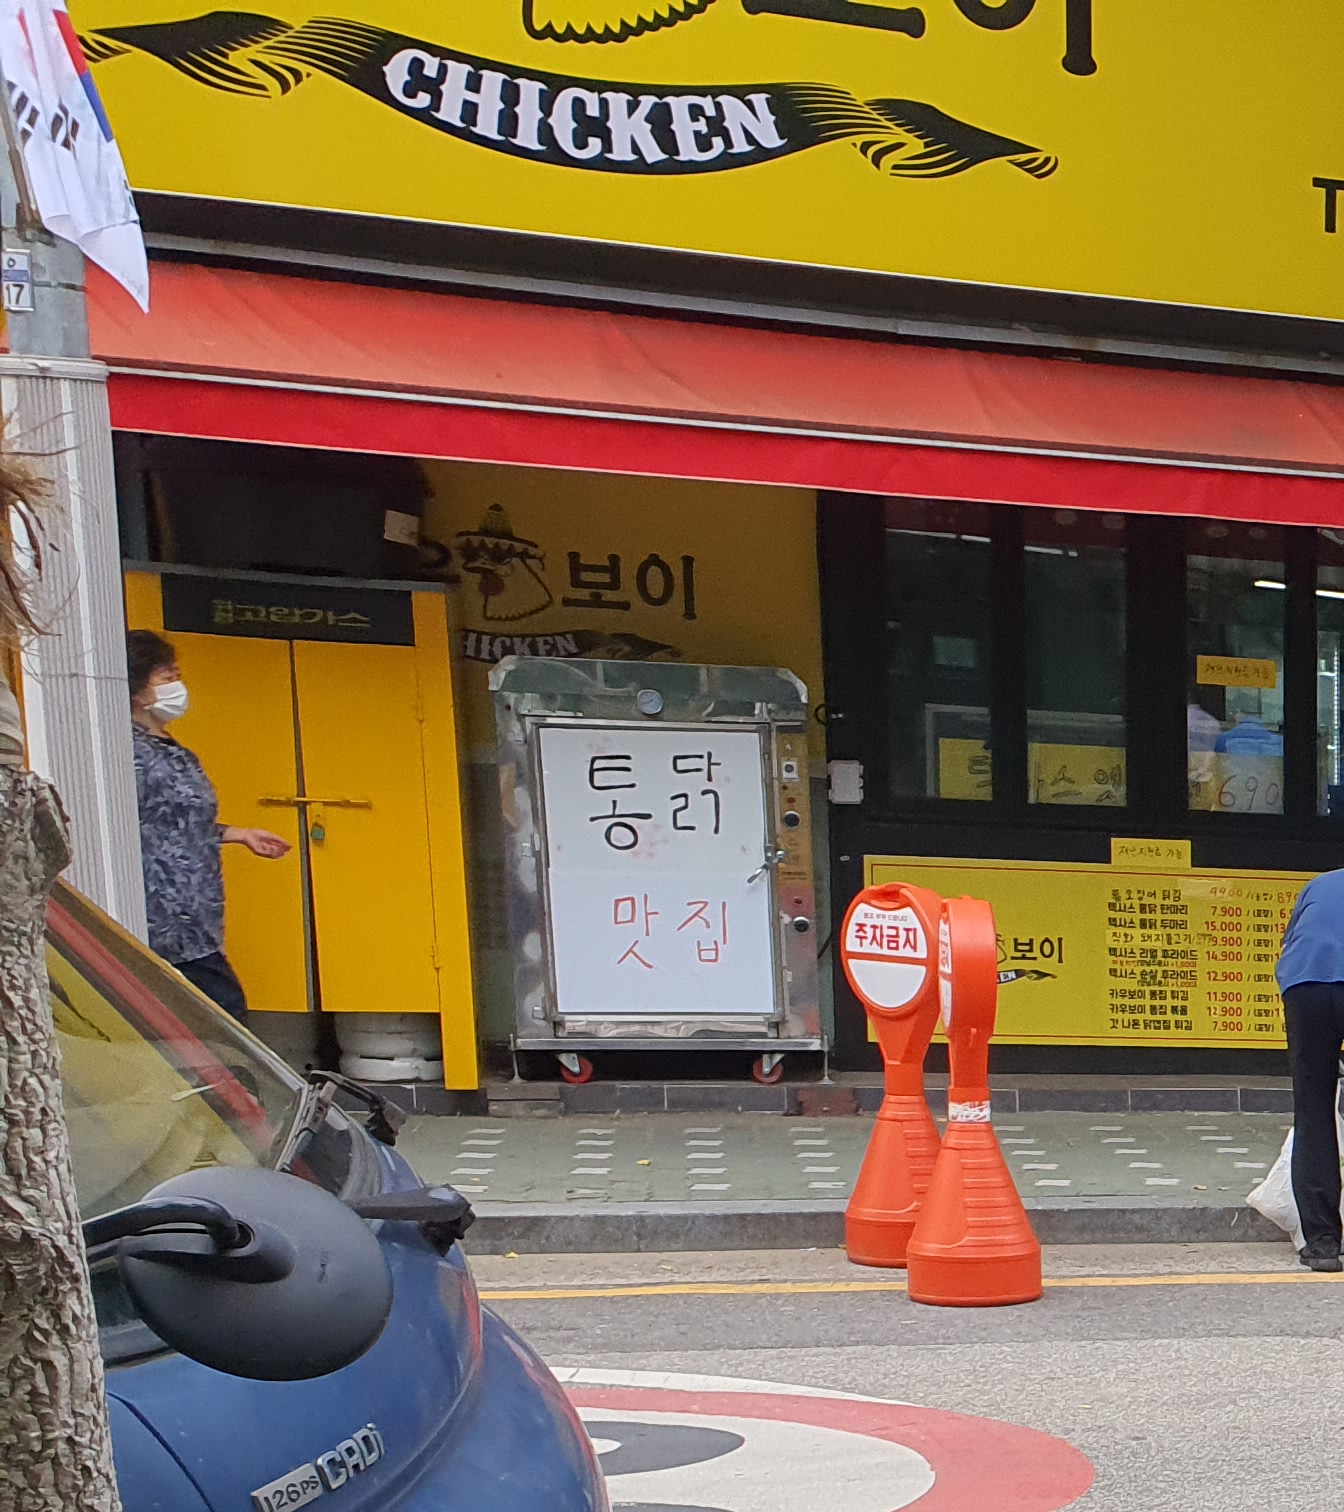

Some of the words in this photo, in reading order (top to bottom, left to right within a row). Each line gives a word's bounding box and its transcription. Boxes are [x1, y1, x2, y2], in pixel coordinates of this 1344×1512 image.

[382, 48, 788, 165] CHICKEN
[562, 550, 697, 620] 보이
[462, 631, 579, 660] HICKEN
[588, 752, 722, 850] 통닭
[1211, 906, 1242, 917] 7.900
[613, 892, 728, 971] 맛집
[1204, 920, 1242, 932] 15.000
[854, 922, 918, 952] 주차금지
[1211, 936, 1243, 946] 9.900
[1010, 937, 1064, 963] 보이
[1205, 950, 1243, 961] 14.900
[1206, 971, 1243, 982] 12.900
[1109, 989, 1146, 1000] 카우보이
[1206, 991, 1243, 1002] 11.900
[1206, 1006, 1243, 1017] 12.900
[1212, 1021, 1243, 1032] 7.900
